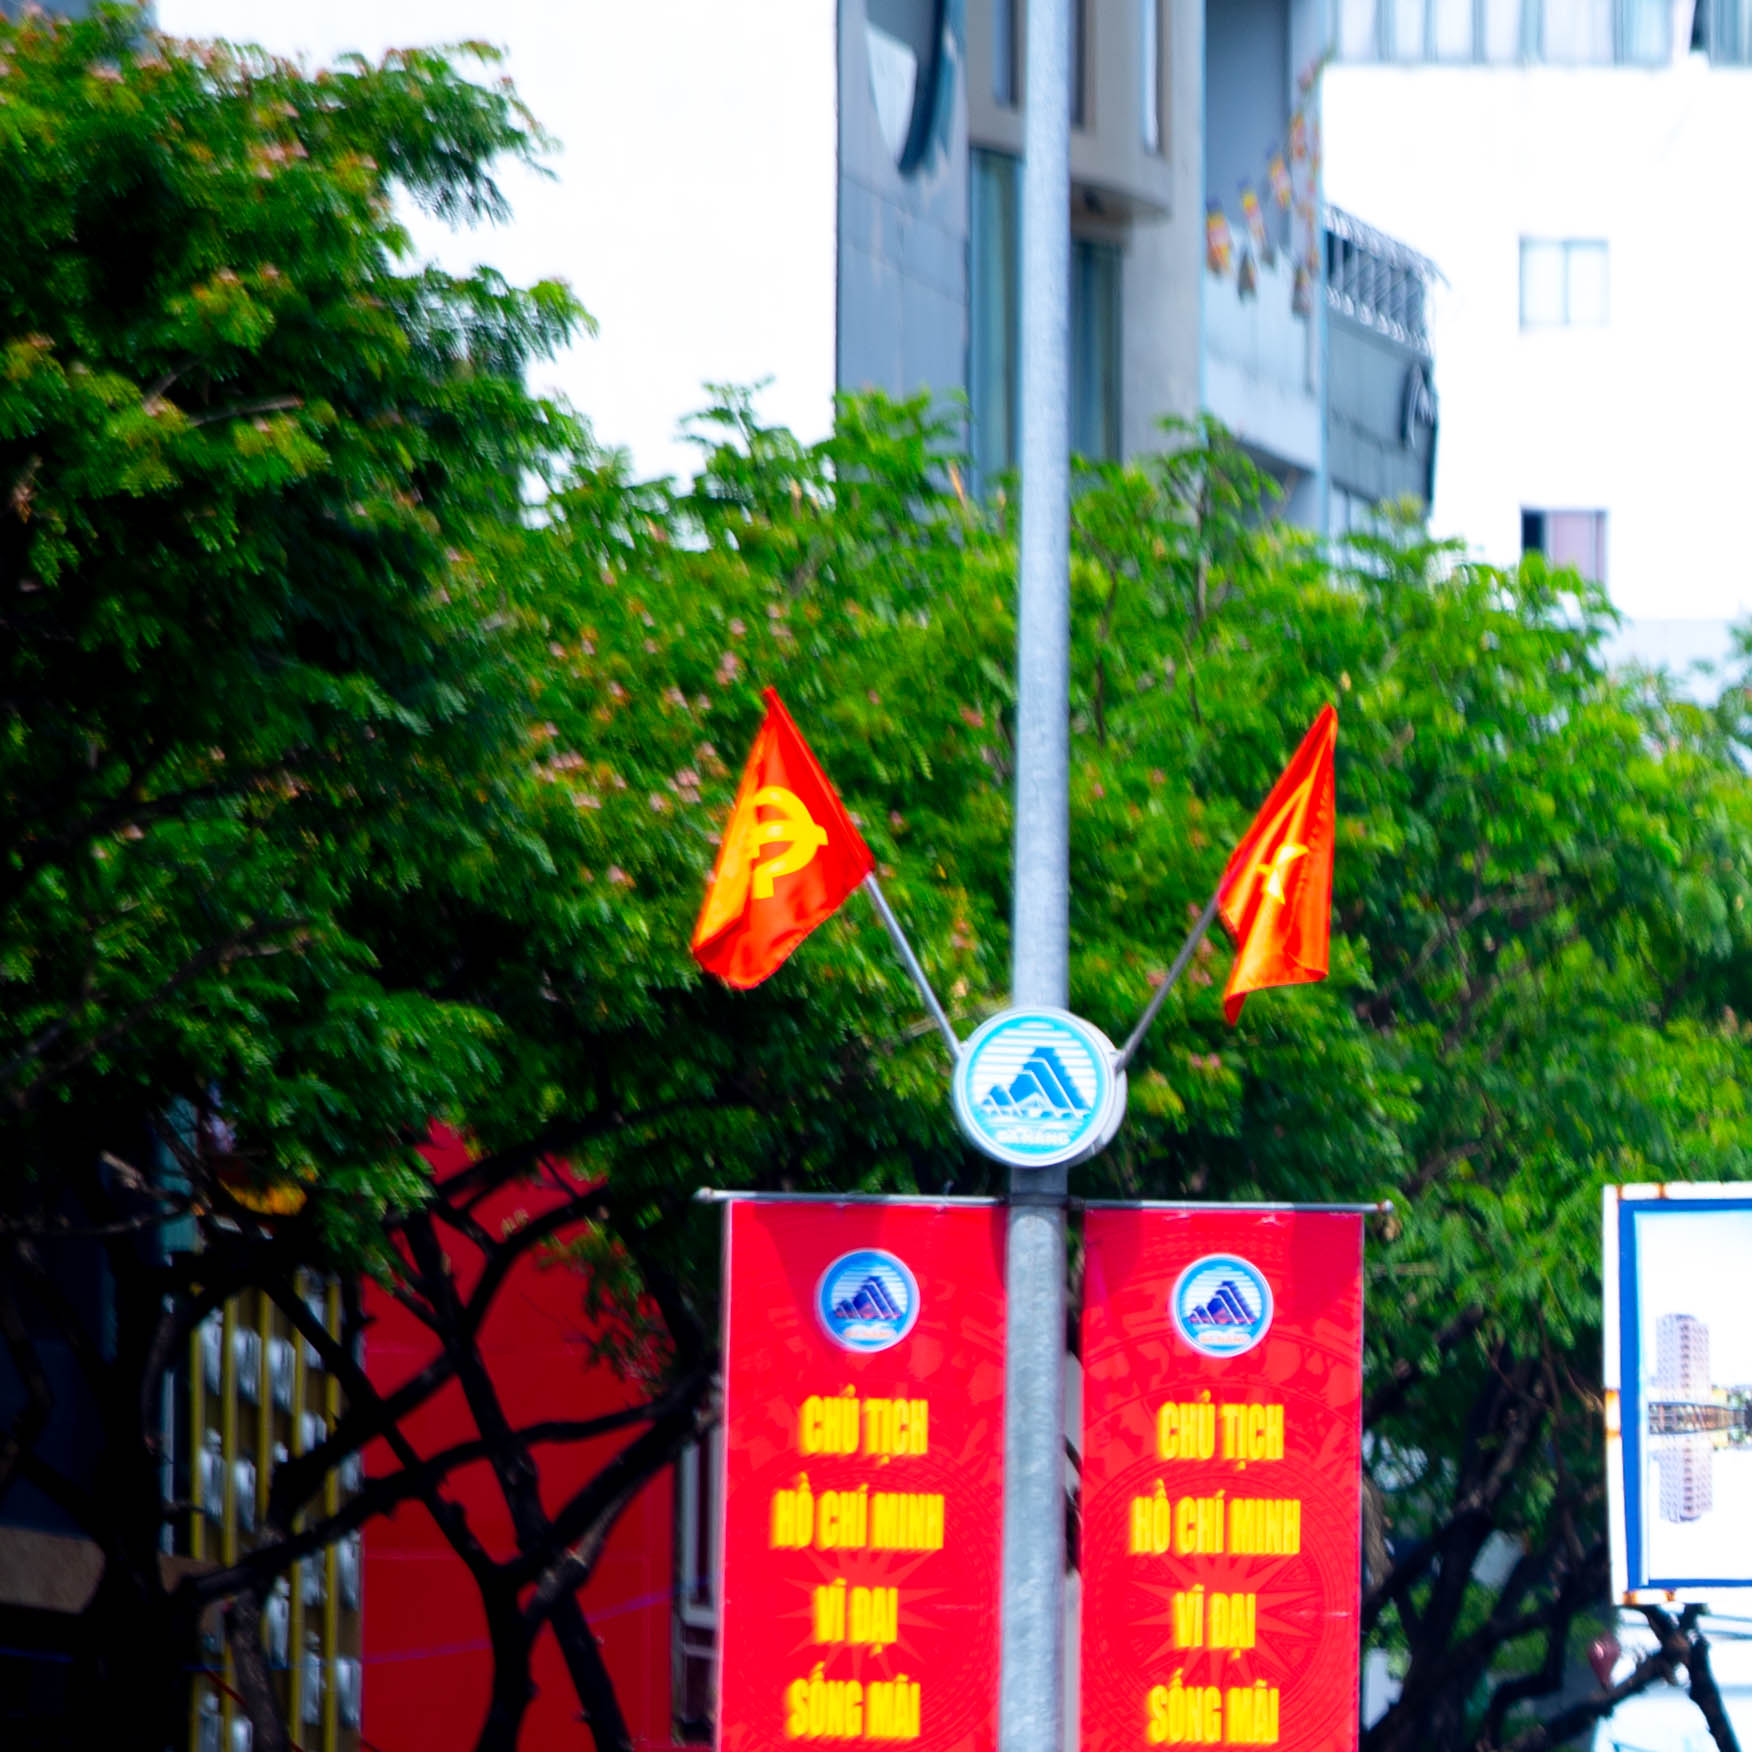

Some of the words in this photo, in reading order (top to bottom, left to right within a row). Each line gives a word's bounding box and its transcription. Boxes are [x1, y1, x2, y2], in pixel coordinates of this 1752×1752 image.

[799, 1385, 860, 1455] CHỦ
[863, 1398, 928, 1464] TỊCH
[1156, 1390, 1216, 1461] CHỦ
[1220, 1403, 1284, 1470] TỊCH
[772, 1472, 814, 1548] HỒ
[818, 1484, 868, 1549] CHÍ
[871, 1493, 944, 1550] MINH
[1129, 1479, 1170, 1555] HỒ
[1175, 1490, 1225, 1555] CHÍ
[1229, 1498, 1300, 1556] MINH
[786, 1662, 862, 1739] SỐNG
[866, 1674, 920, 1740] MÃI
[1146, 1668, 1222, 1745] SỐNG
[1226, 1679, 1279, 1745] MÃI
